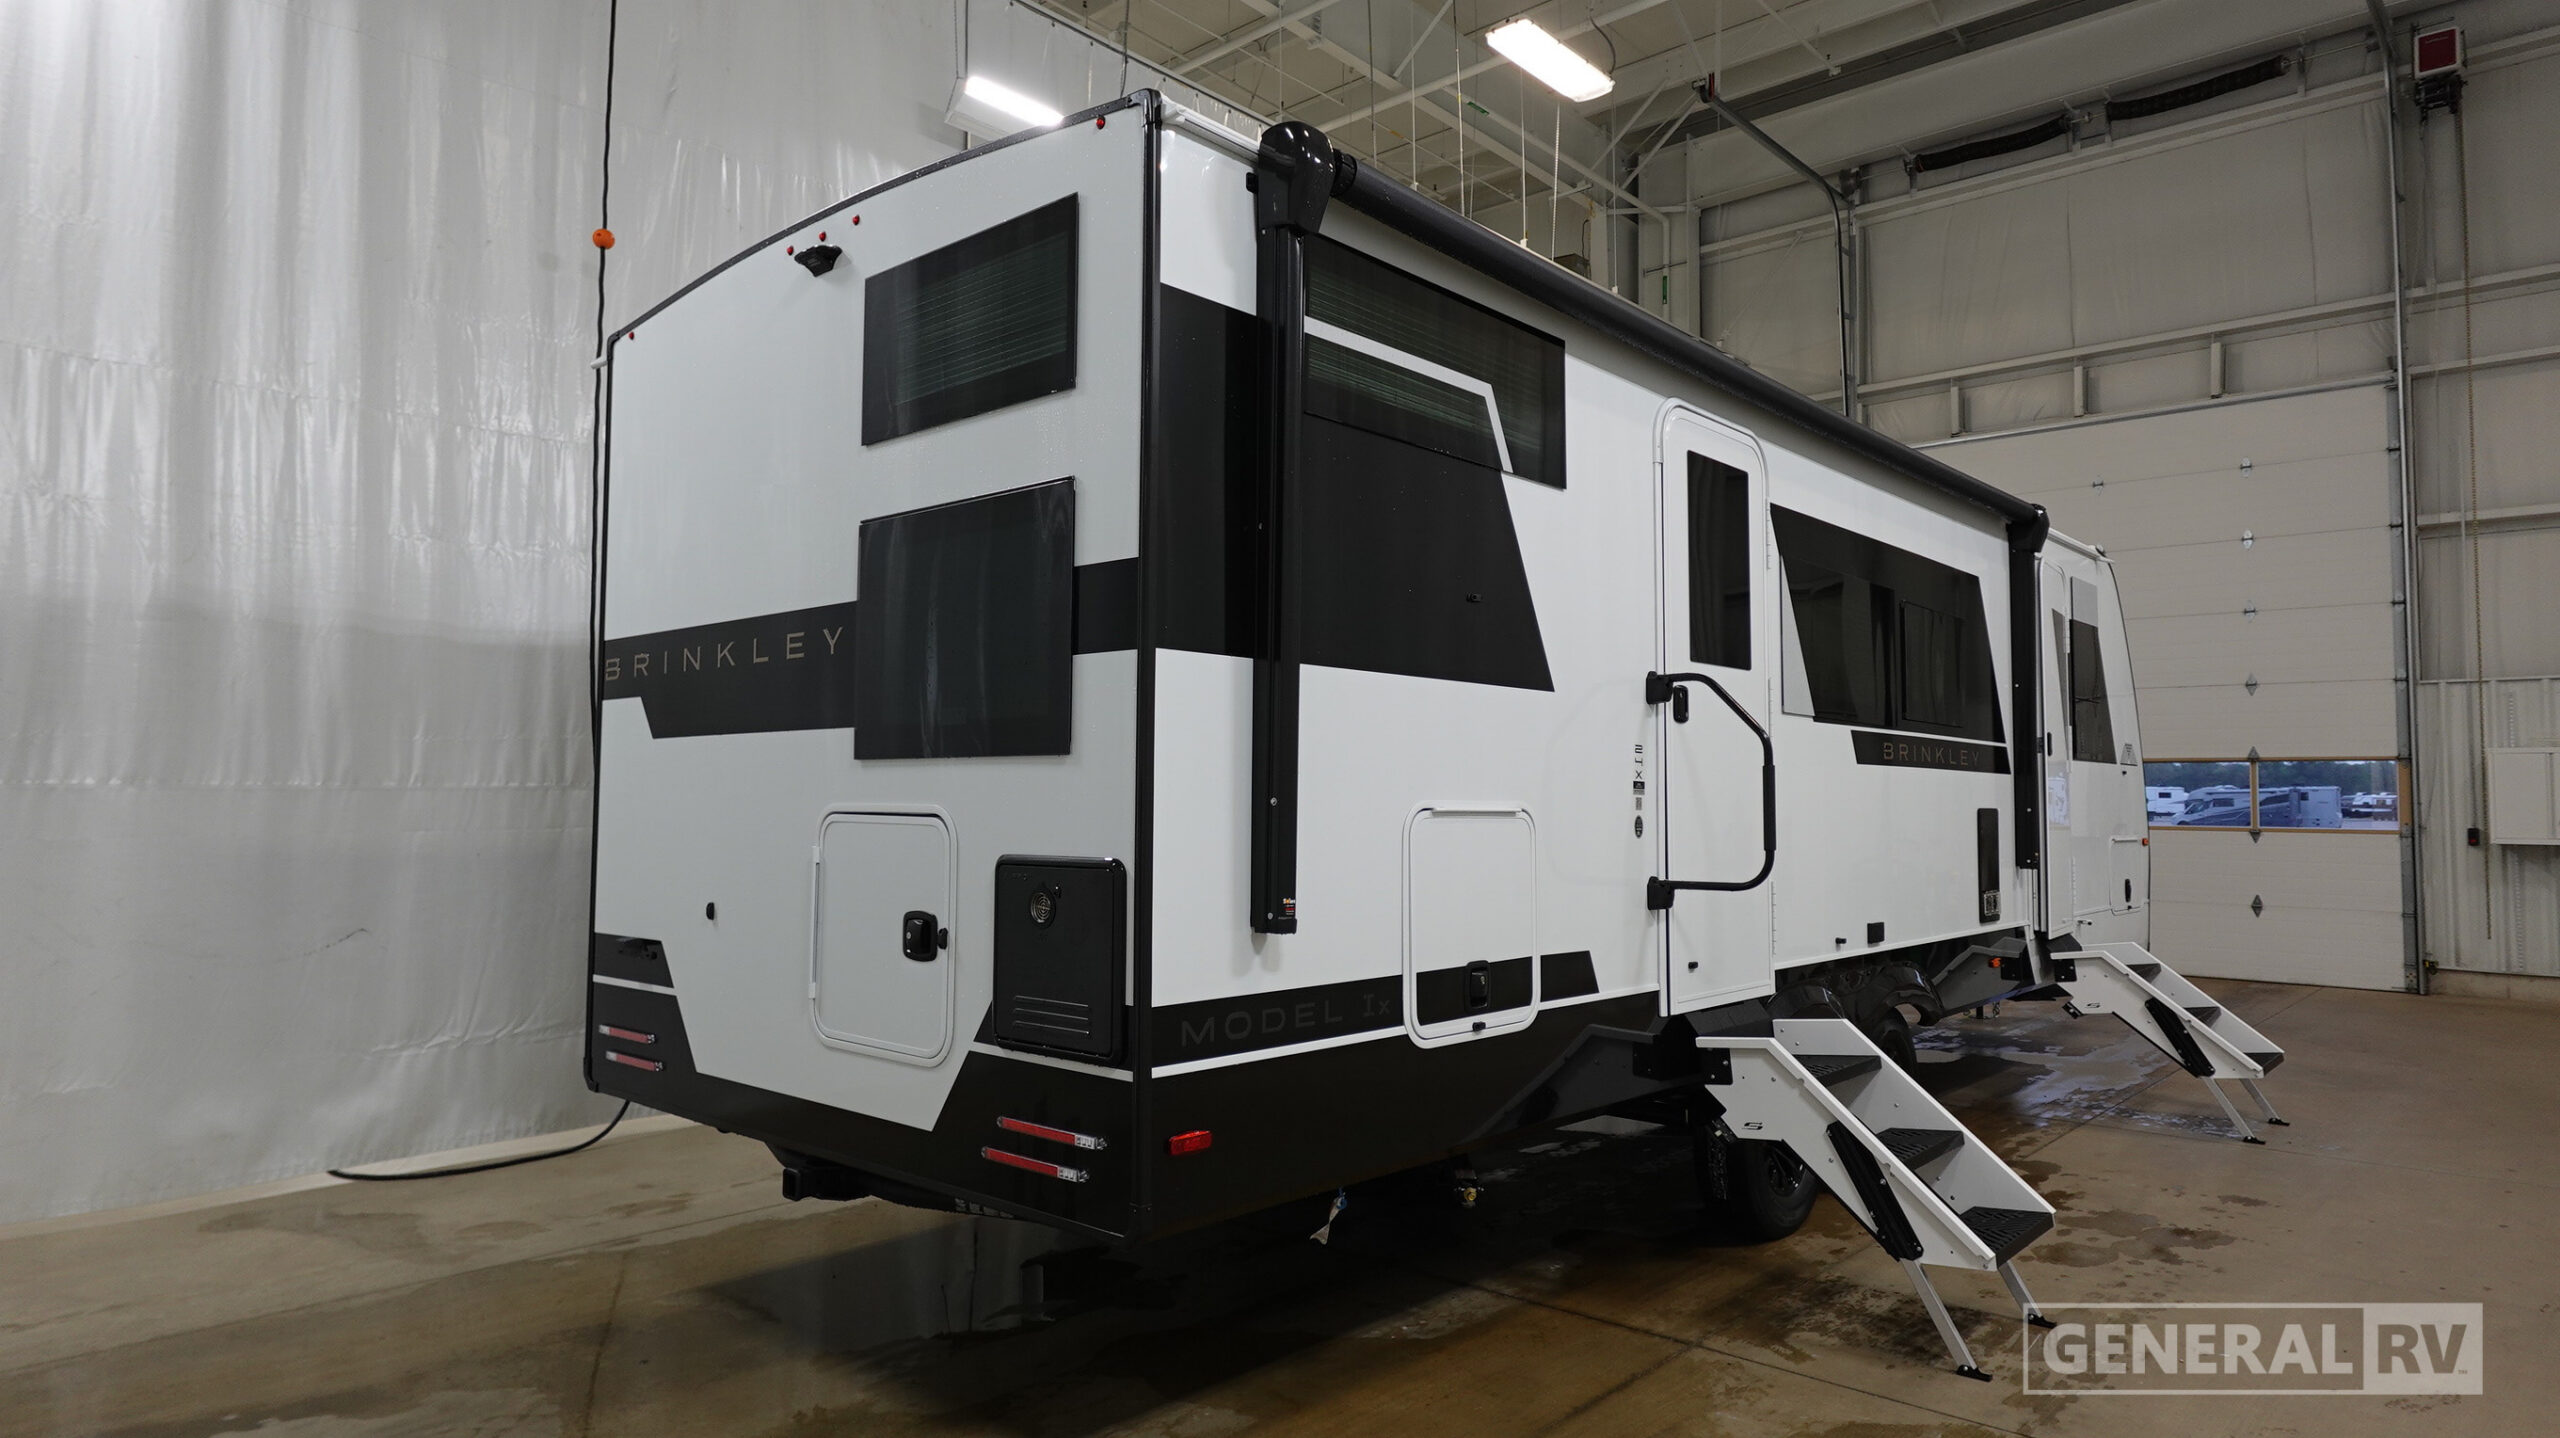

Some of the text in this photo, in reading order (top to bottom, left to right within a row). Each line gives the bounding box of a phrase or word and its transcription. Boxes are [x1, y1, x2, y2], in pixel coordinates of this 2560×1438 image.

[605, 626, 843, 681] BRINKLEY
[1883, 742, 1980, 766] BRINKLEY
[1181, 1000, 1344, 1047] MODEL
